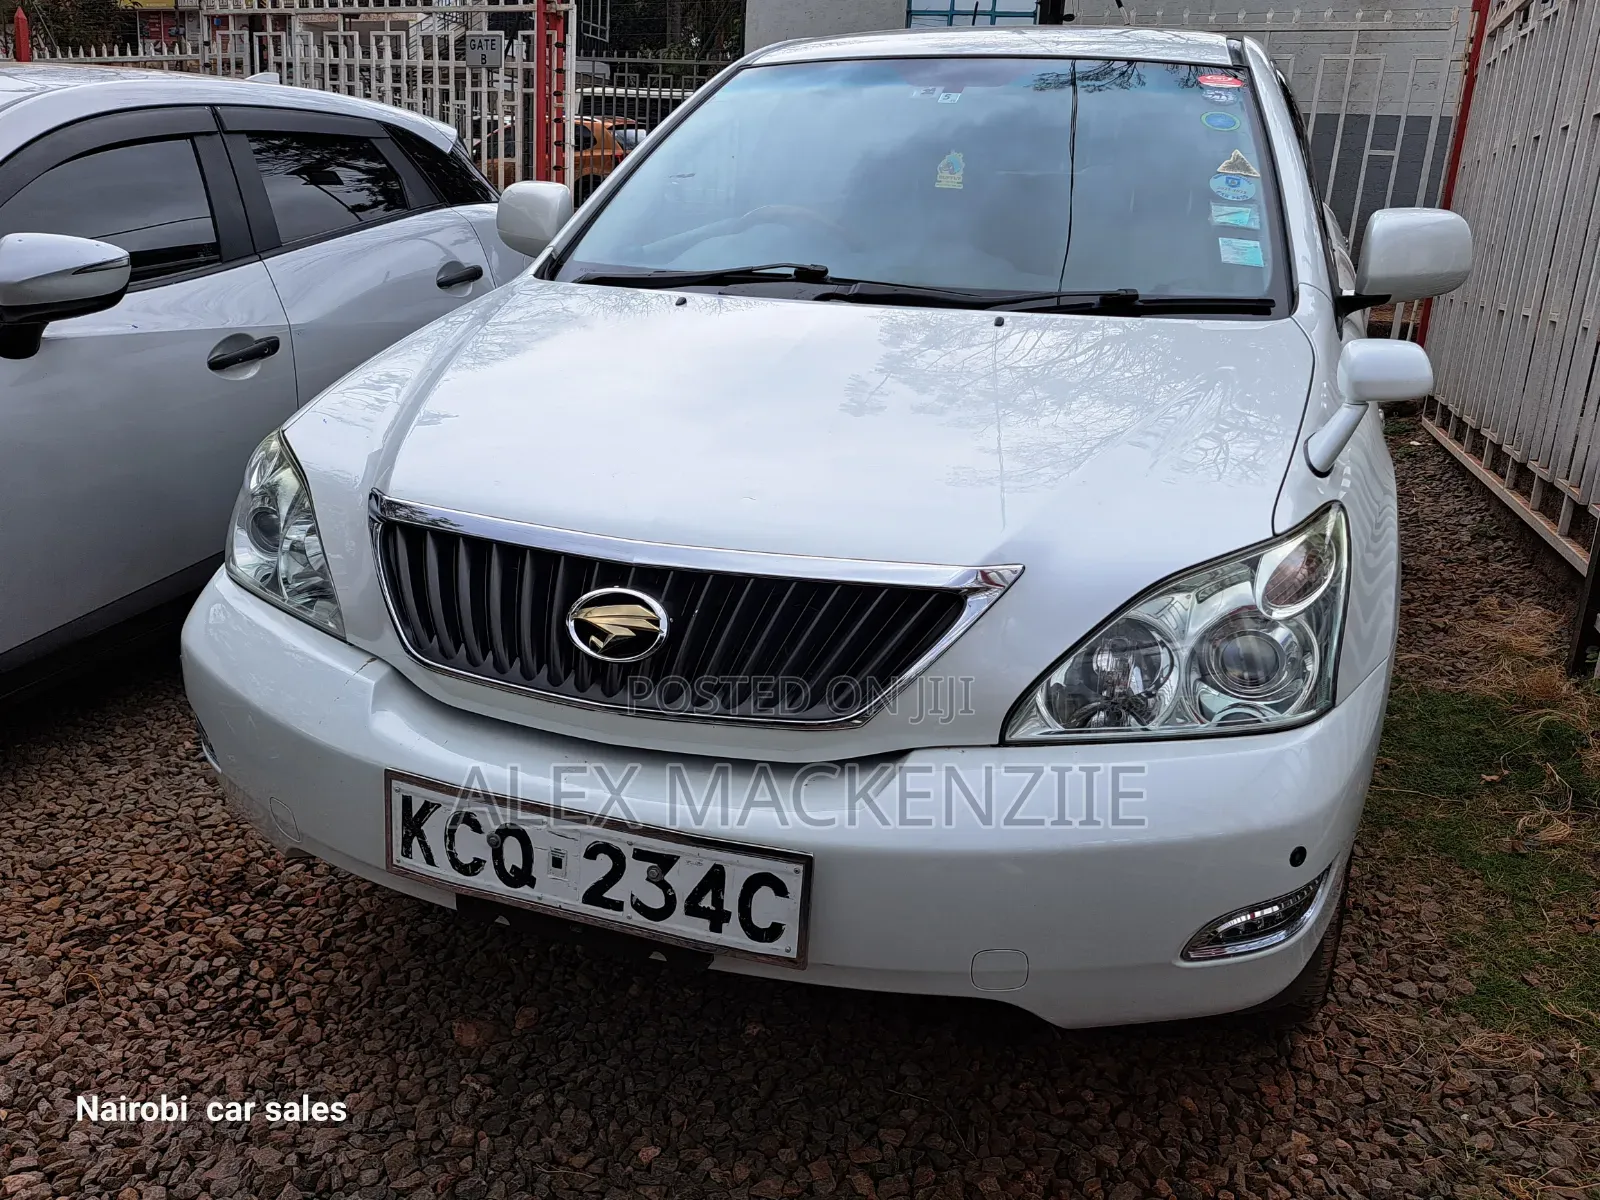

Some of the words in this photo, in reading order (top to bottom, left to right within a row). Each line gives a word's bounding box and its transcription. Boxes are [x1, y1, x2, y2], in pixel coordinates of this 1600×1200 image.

[469, 38, 496, 51] GATE
[480, 53, 487, 65] B
[400, 794, 536, 890] KCQ
[581, 840, 791, 943] 234C
